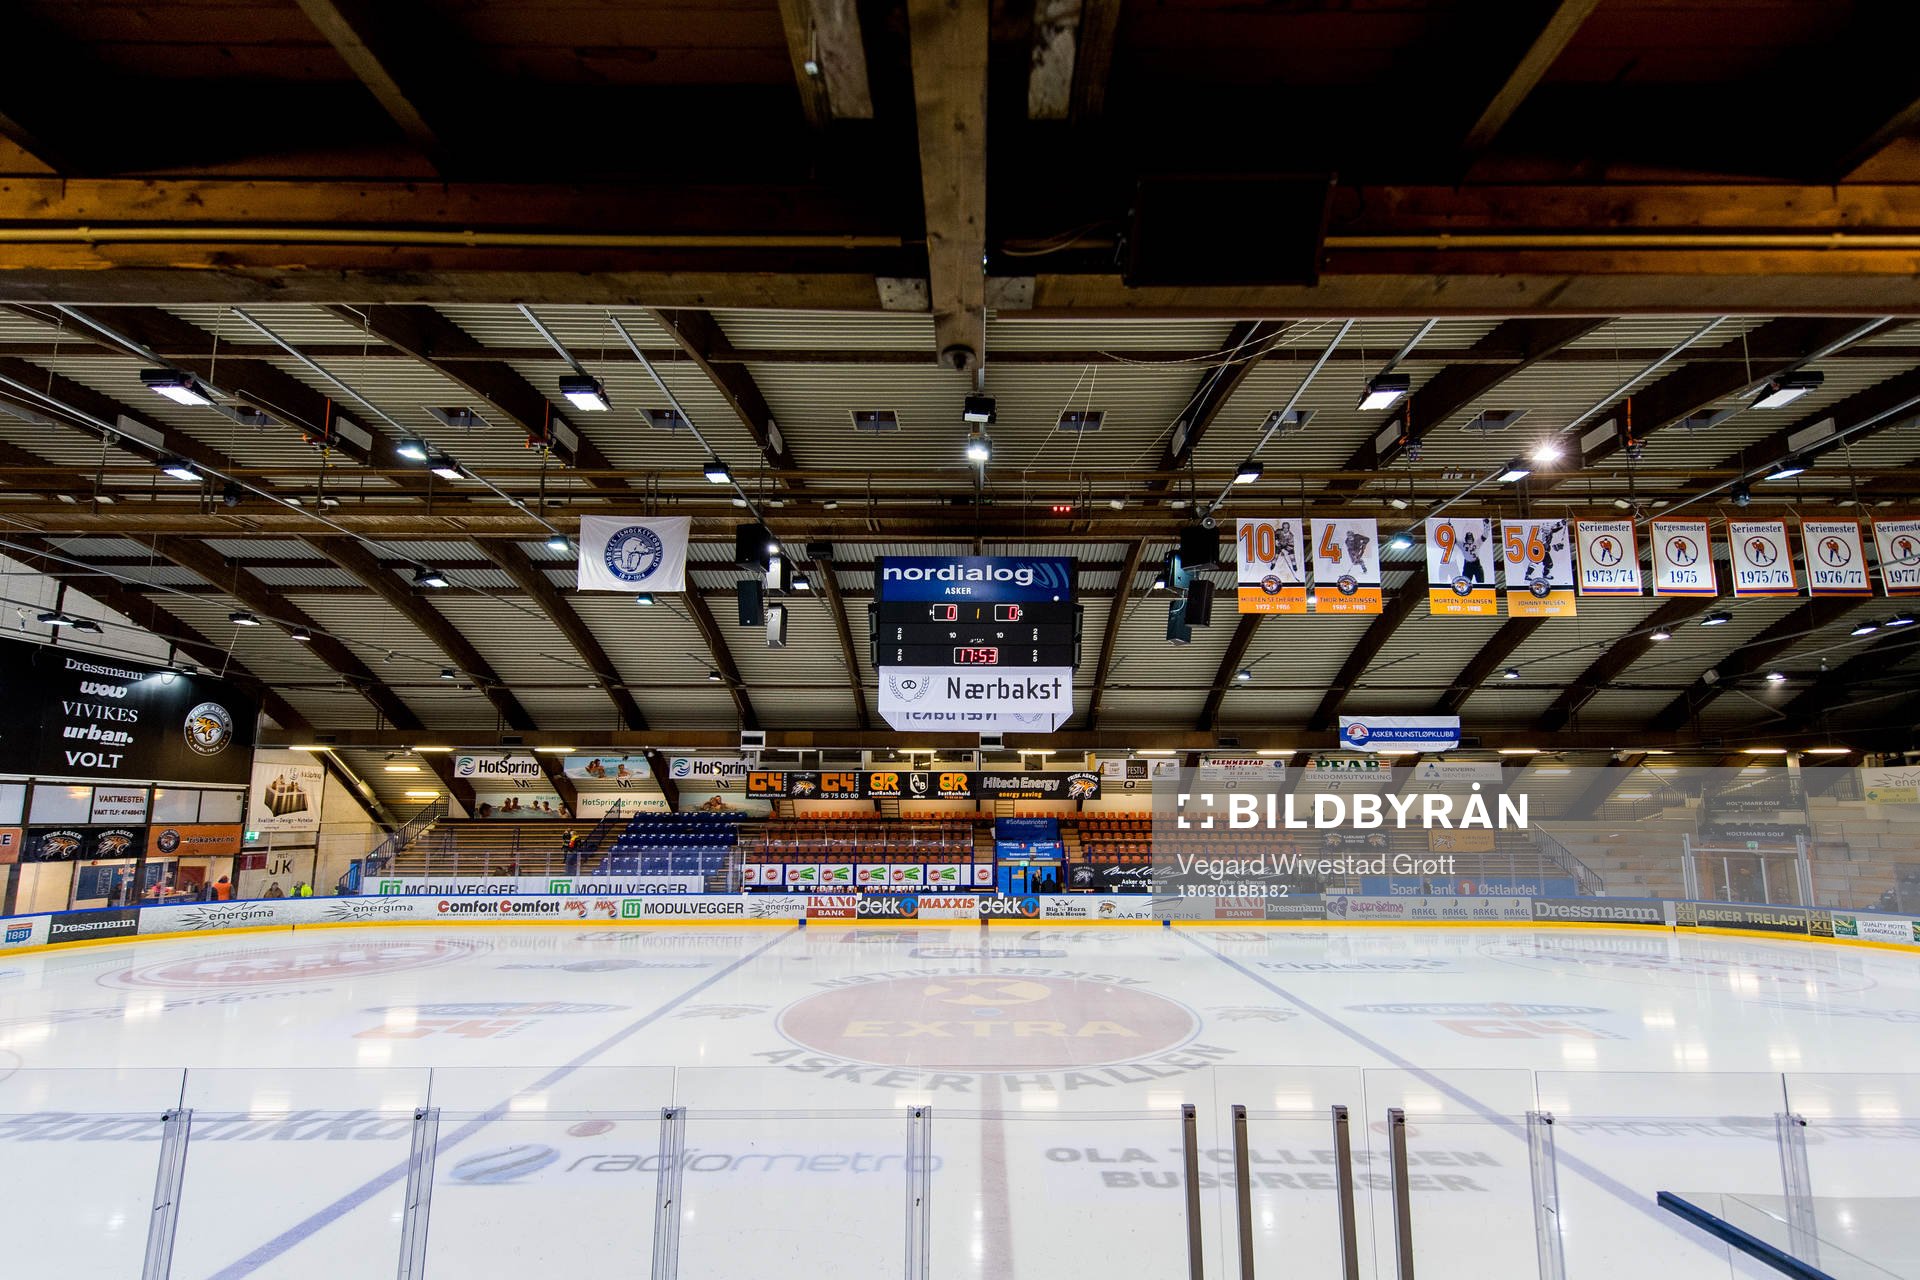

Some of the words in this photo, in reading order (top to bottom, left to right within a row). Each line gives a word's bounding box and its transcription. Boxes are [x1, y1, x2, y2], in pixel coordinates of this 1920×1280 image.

[1579, 522, 1630, 532] Seriemester
[1654, 522, 1705, 533] Norgesmester
[1731, 523, 1782, 533] Seriemester
[1805, 523, 1856, 533] Seriemester
[1239, 522, 1276, 564] 10
[1319, 523, 1342, 564] 4
[1434, 523, 1456, 565] 9
[1503, 525, 1546, 564] 56
[882, 564, 1034, 586] nordialog
[1586, 569, 1634, 583] 1973/74
[1670, 570, 1698, 583] 1975
[1740, 570, 1789, 584] 1975/76
[1815, 570, 1862, 584] 1976/77
[945, 587, 972, 595] ASKER
[946, 605, 956, 620] 0
[1008, 606, 1018, 620] 0
[960, 649, 997, 662] 17:53
[64, 658, 144, 681] Dressmann
[80, 681, 128, 698] wow
[947, 677, 1062, 700] Nærbakst
[62, 701, 139, 723] VIVIKES
[190, 705, 208, 719] FRISK
[63, 724, 134, 744] urban.
[65, 751, 123, 769] VOLT
[1316, 760, 1380, 773] PEAB
[478, 760, 540, 776] HotSpring
[617, 780, 632, 788] M
[716, 780, 730, 788] N
[749, 772, 783, 791] G4
[821, 773, 854, 791] G4
[982, 776, 1020, 789] Hitech
[1020, 777, 1060, 792] Energy
[1067, 773, 1082, 782] FRISK
[1082, 772, 1099, 783] ASKER
[1123, 780, 1136, 788] Q
[1328, 781, 1341, 789] R
[98, 795, 145, 804] VAKTMESTER
[42, 831, 61, 841] FRISK
[61, 830, 83, 840] ASKER
[97, 829, 115, 840] FRISK
[115, 829, 134, 839] ASKER
[404, 884, 519, 895] MODULVEGGER
[576, 883, 688, 893] MODULVEGGER
[1478, 883, 1538, 895] Østlandet
[438, 900, 498, 913] Comfort
[500, 899, 560, 913] Comfort
[644, 902, 744, 914] MODULVEGGER
[807, 896, 857, 907] IKANO
[857, 898, 900, 914] dekk
[919, 898, 976, 909] MAXXIS
[979, 898, 1022, 915] dekk
[1215, 897, 1264, 907] IKANO
[1267, 903, 1326, 913] Dressmann
[208, 909, 274, 920] energima
[353, 903, 413, 914] energima
[765, 903, 805, 914] energima
[1411, 908, 1437, 916] ARKEL
[1442, 908, 1468, 916] ARKEL
[1473, 908, 1498, 916] ARKEL
[1504, 908, 1530, 916] ARKEL
[1534, 902, 1660, 921] Dressmann
[1698, 909, 1742, 922] ASKER
[1745, 912, 1806, 927] TRELAST
[51, 918, 136, 935] Dressmann
[7, 930, 30, 939] 1881
[841, 1020, 1144, 1038] EXTRA
[751, 1047, 972, 1093] ASKER
[1004, 1042, 1238, 1093] HALLEN
[1043, 1147, 1160, 1165] OLA
